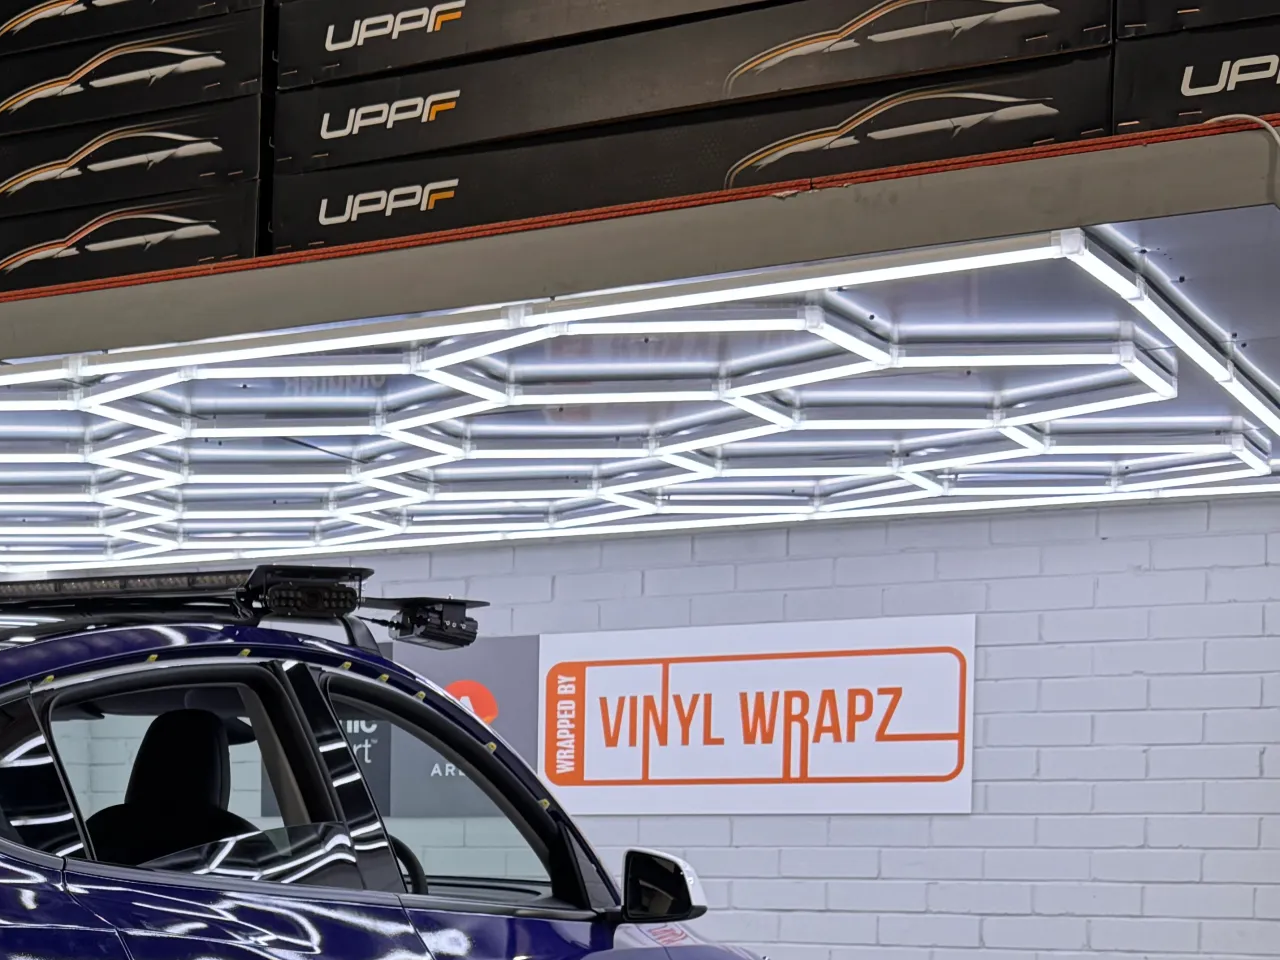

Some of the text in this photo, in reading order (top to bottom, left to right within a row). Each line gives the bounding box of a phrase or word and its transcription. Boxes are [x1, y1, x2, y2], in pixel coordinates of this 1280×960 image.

[324, 0, 467, 52] UPPF
[1180, 54, 1280, 97] UP
[320, 89, 461, 140] UPPF
[318, 178, 459, 226] UPPF
[556, 674, 577, 775] WRAPPED BY
[598, 686, 907, 776] VINYL WRAPZ
